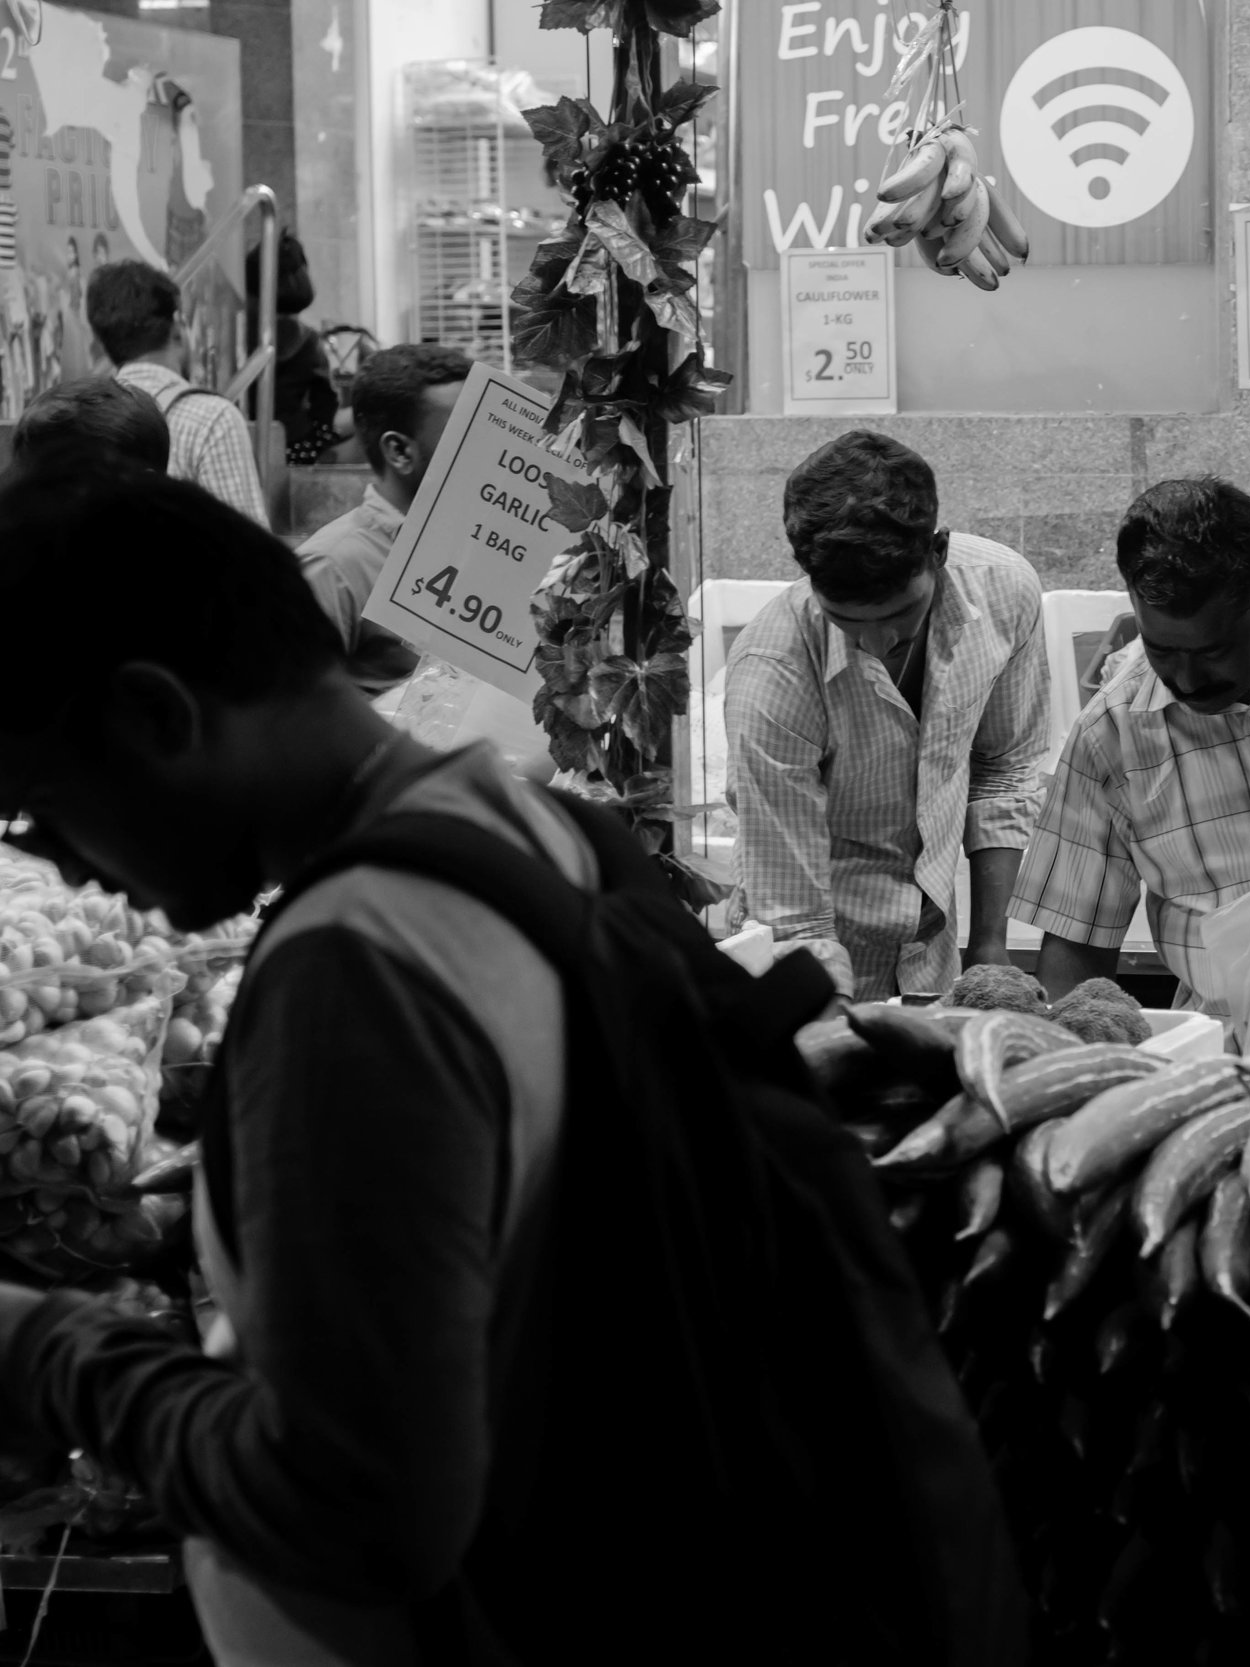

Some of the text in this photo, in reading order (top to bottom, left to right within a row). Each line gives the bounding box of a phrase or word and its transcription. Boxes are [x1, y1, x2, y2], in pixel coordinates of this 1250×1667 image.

[778, 0, 970, 76] Enjoy
[796, 290, 879, 302] CAULIFLOWER
[823, 313, 853, 325] 1-KG
[844, 363, 874, 375] ONLY
[501, 398, 518, 413] ALL
[487, 412, 507, 429] THIS
[508, 424, 534, 444] WEEK
[479, 483, 550, 532] GARLIC
[470, 524, 528, 562] 1 BAG
[495, 630, 523, 649] ONLY
